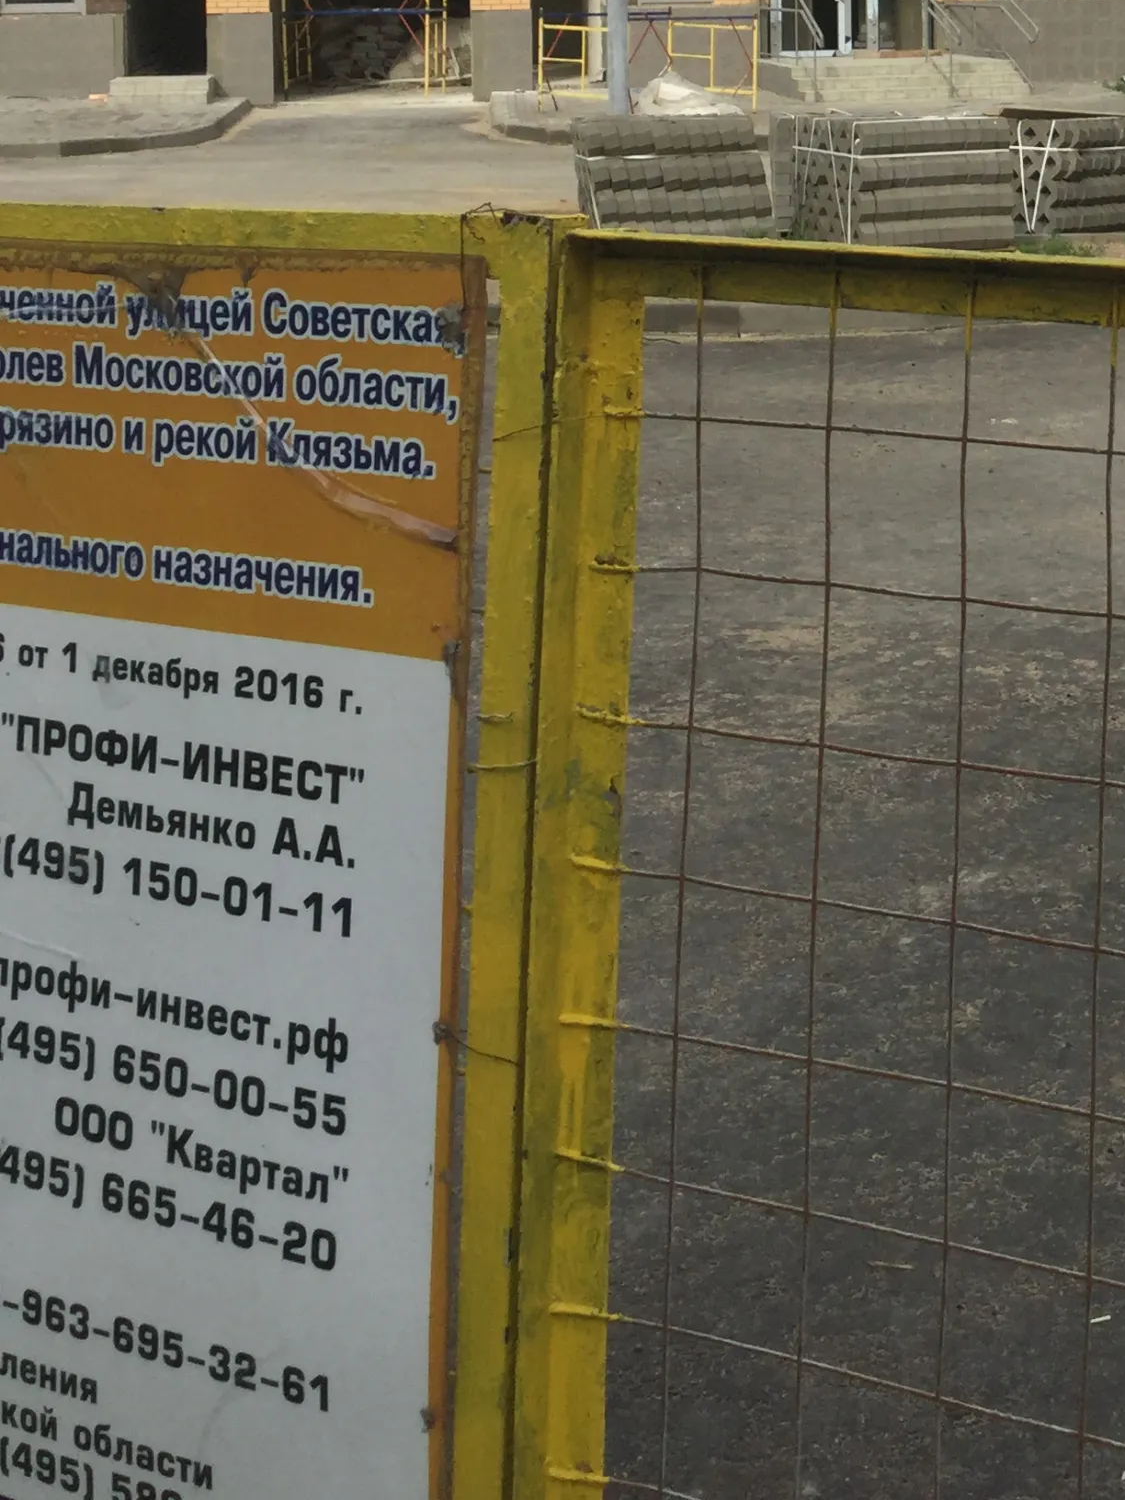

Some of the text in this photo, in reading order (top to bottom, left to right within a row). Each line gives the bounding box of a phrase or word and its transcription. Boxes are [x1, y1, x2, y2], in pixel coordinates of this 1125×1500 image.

[0, 344, 458, 421] лев Московской области,
[124, 420, 144, 451] и
[154, 417, 256, 463] рекой
[267, 421, 434, 477] Клязьма.
[154, 549, 372, 604] назначения.
[18, 644, 49, 669] от
[62, 642, 77, 673] 1
[92, 655, 219, 695] декабря
[234, 665, 324, 709] 2016
[339, 689, 363, 715] г.
[2, 712, 365, 805] "ПРОФИ-ИНВЕСТ"
[67, 781, 355, 869] Демьянко А.А.
[3, 833, 352, 938] (495) 150-01-11
[113, 1044, 347, 1136] 650-00-55
[54, 1096, 349, 1203] ООО "Квартал"
[102, 1172, 337, 1272] 665-46-20
[0, 1351, 98, 1405] ления
[1, 1400, 213, 1491] кой области
